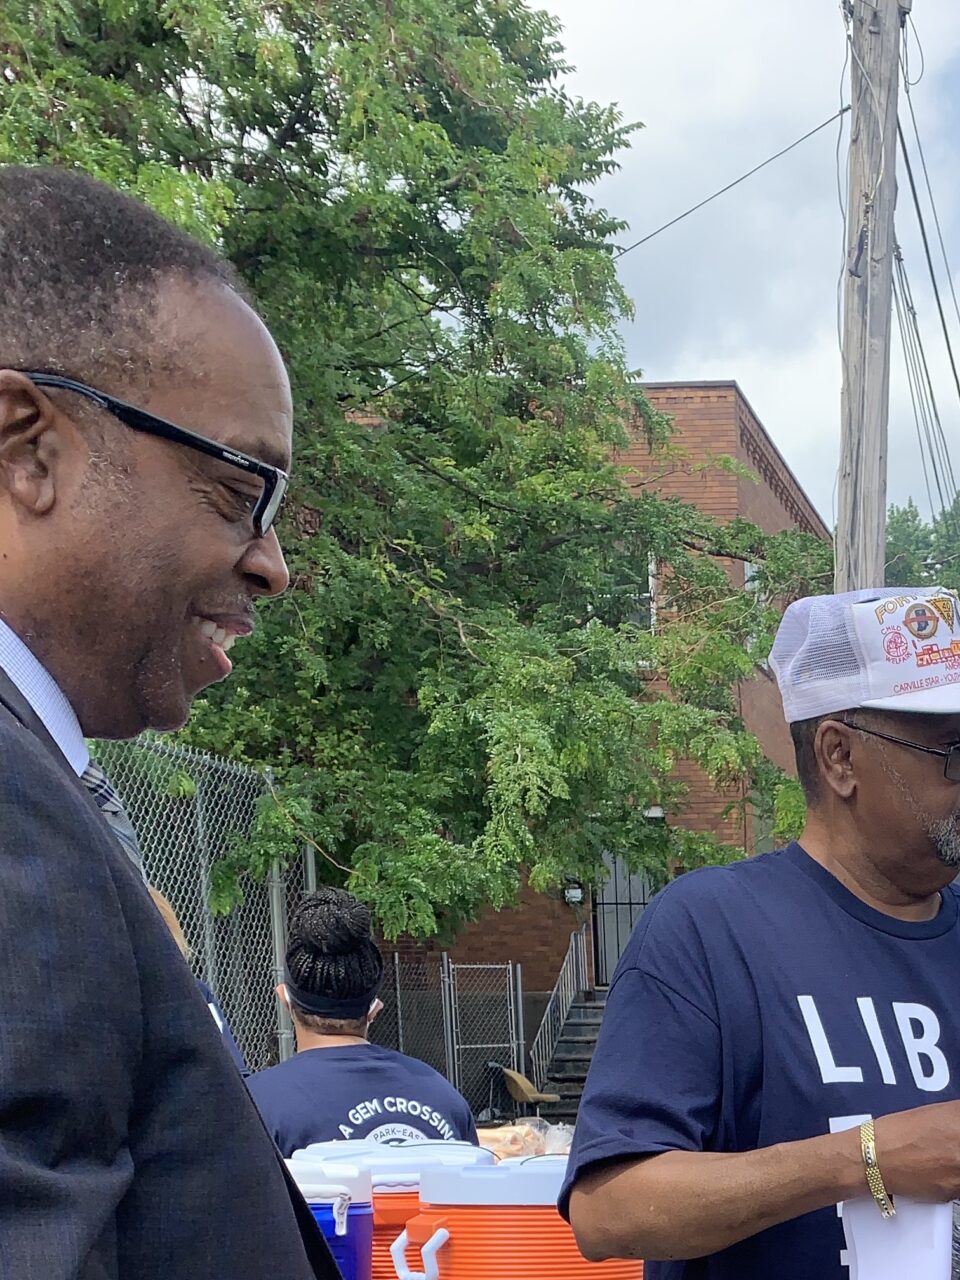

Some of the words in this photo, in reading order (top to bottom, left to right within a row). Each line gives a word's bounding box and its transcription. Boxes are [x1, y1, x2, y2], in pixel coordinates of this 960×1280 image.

[880, 625, 901, 635] CHILD
[893, 679, 922, 693] CARVILLE
[923, 676, 939, 688] STAR
[338, 1123, 354, 1139] A
[348, 1098, 382, 1125] GEM
[383, 1096, 456, 1141] CROSSIN
[373, 1128, 424, 1141] PARK-EAS
